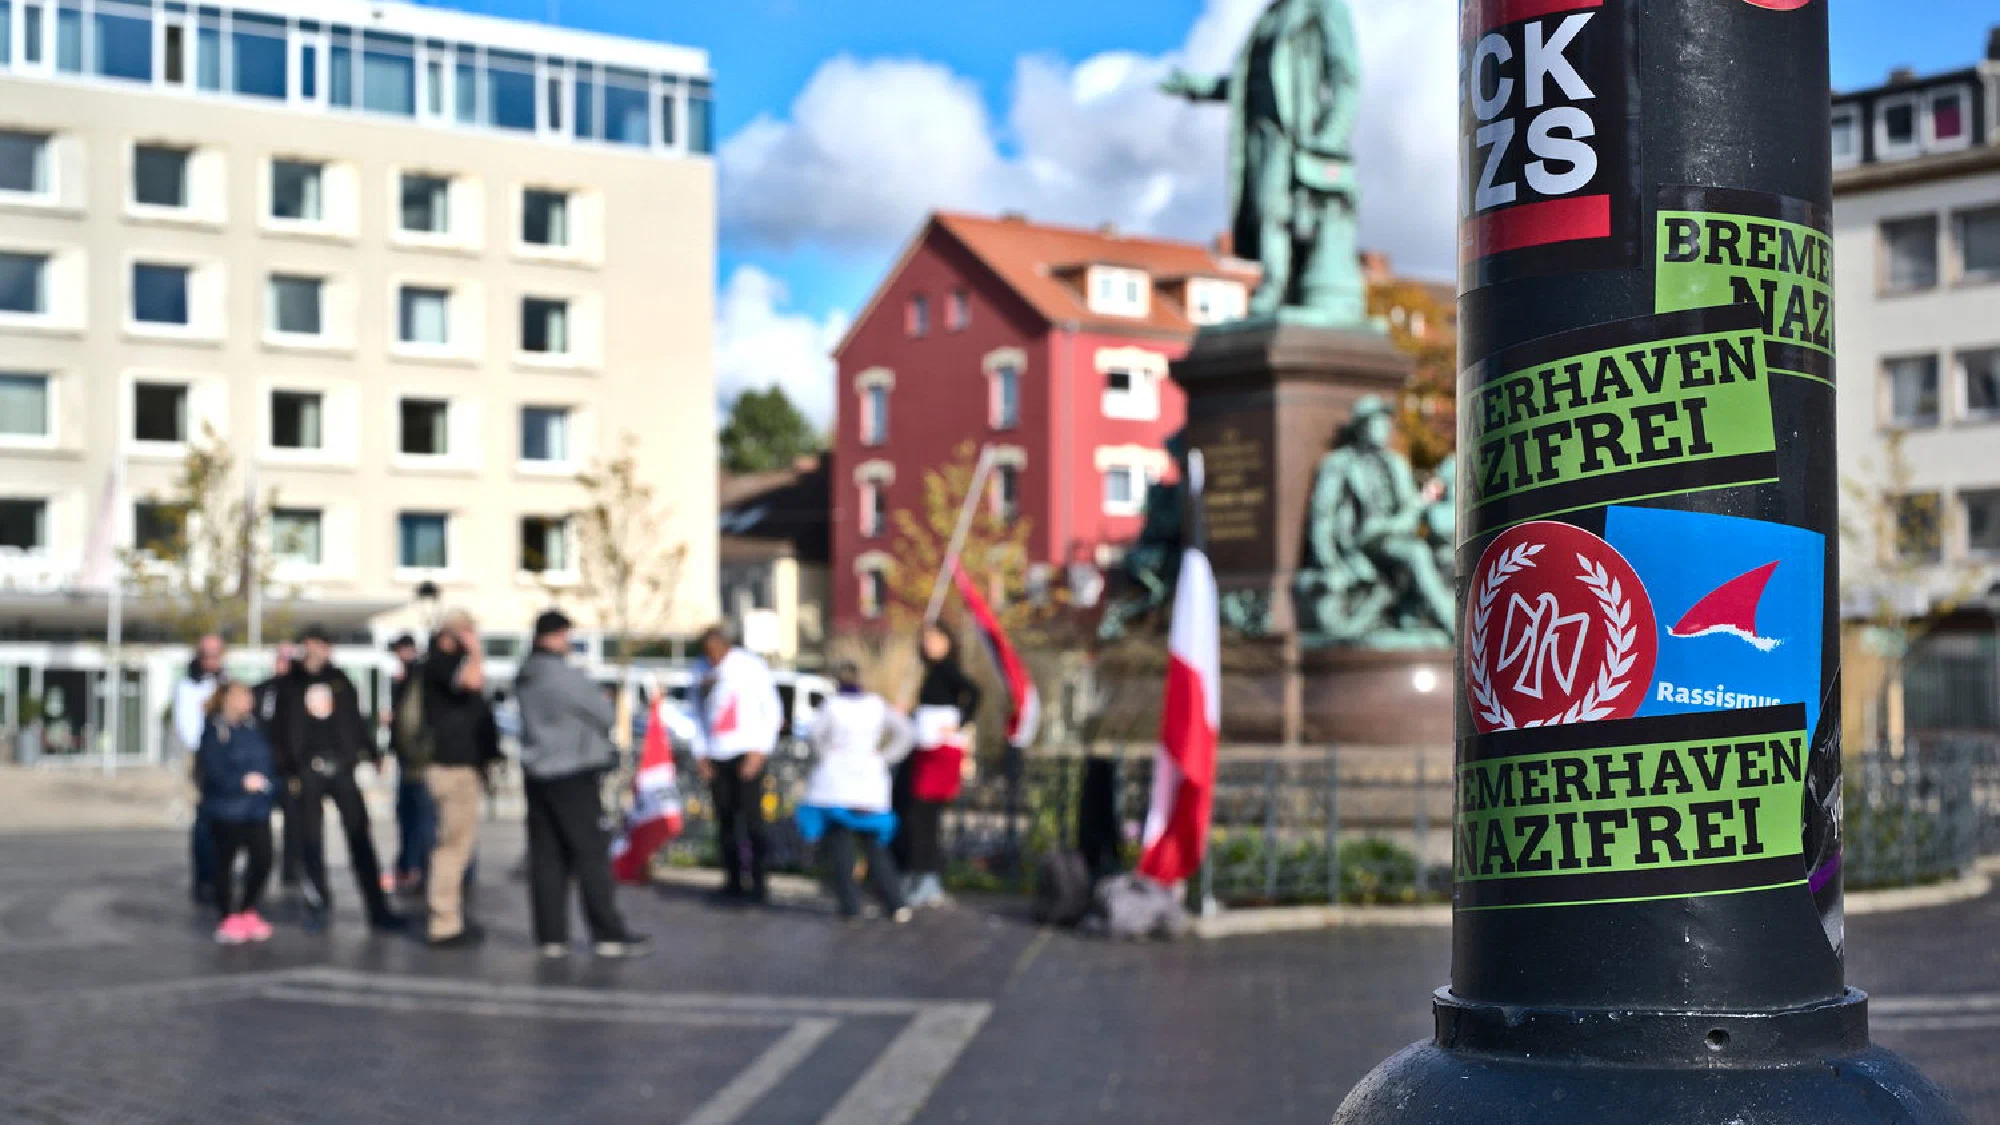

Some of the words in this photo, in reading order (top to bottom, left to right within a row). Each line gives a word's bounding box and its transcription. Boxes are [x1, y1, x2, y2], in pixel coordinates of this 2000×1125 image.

[1460, 12, 1597, 120] CK
[1729, 275, 1836, 351] NAZ
[1458, 797, 1765, 876] NAZIFREI
